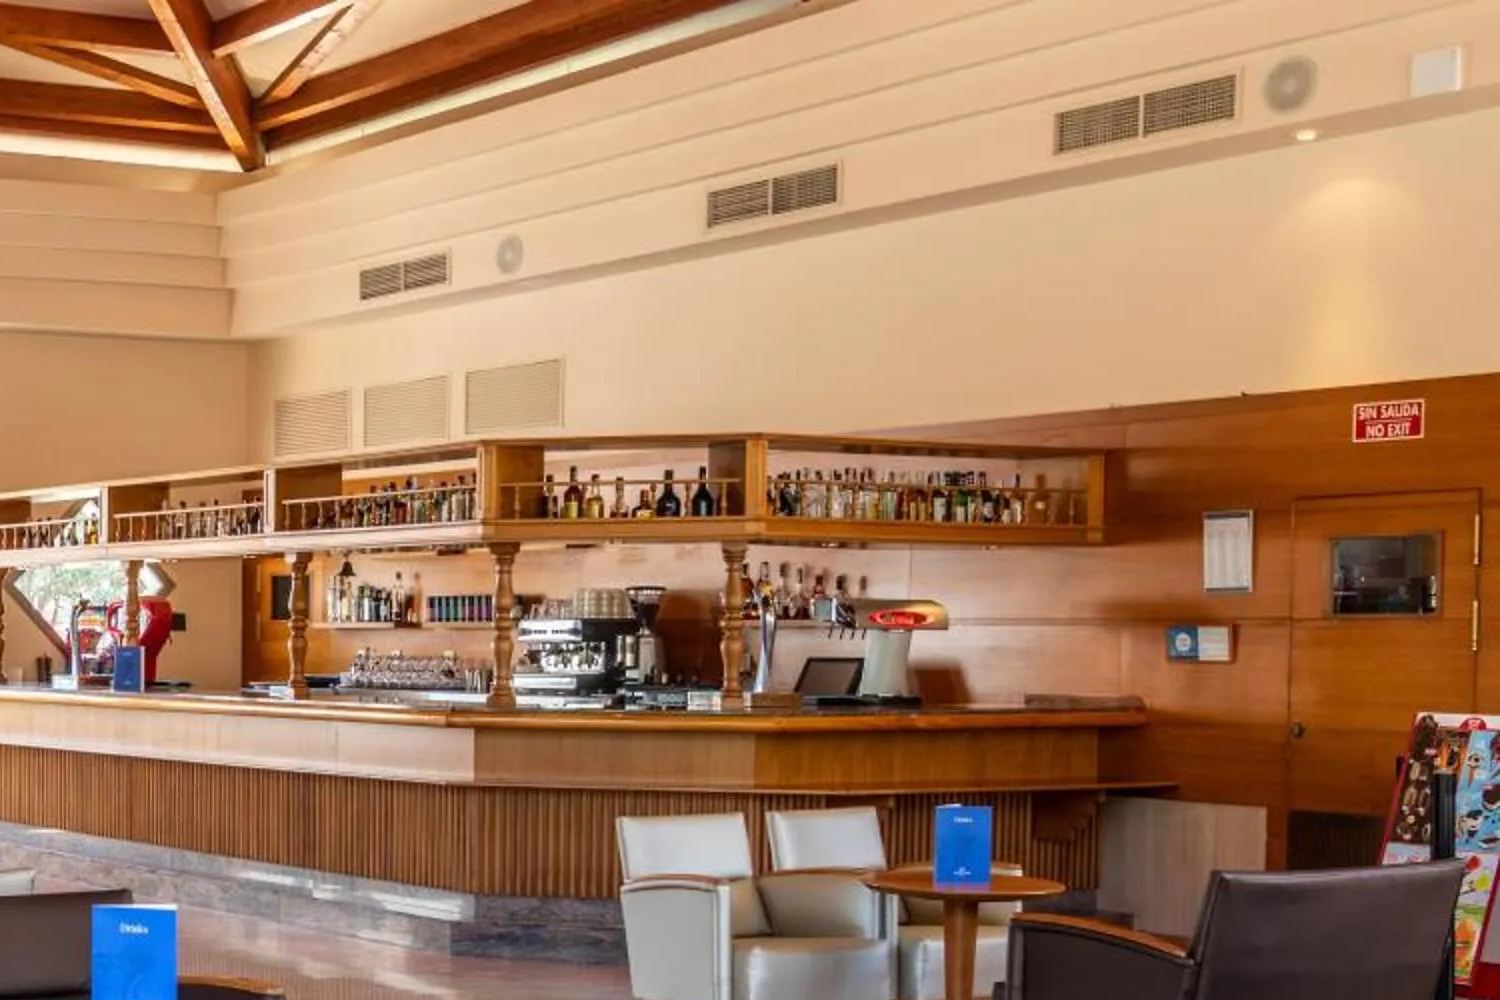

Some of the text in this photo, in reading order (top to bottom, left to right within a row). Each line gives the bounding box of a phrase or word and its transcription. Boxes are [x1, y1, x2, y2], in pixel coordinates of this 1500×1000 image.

[1357, 403, 1419, 420] SIN SALIDA
[1365, 422, 1411, 438] NO EXIT
